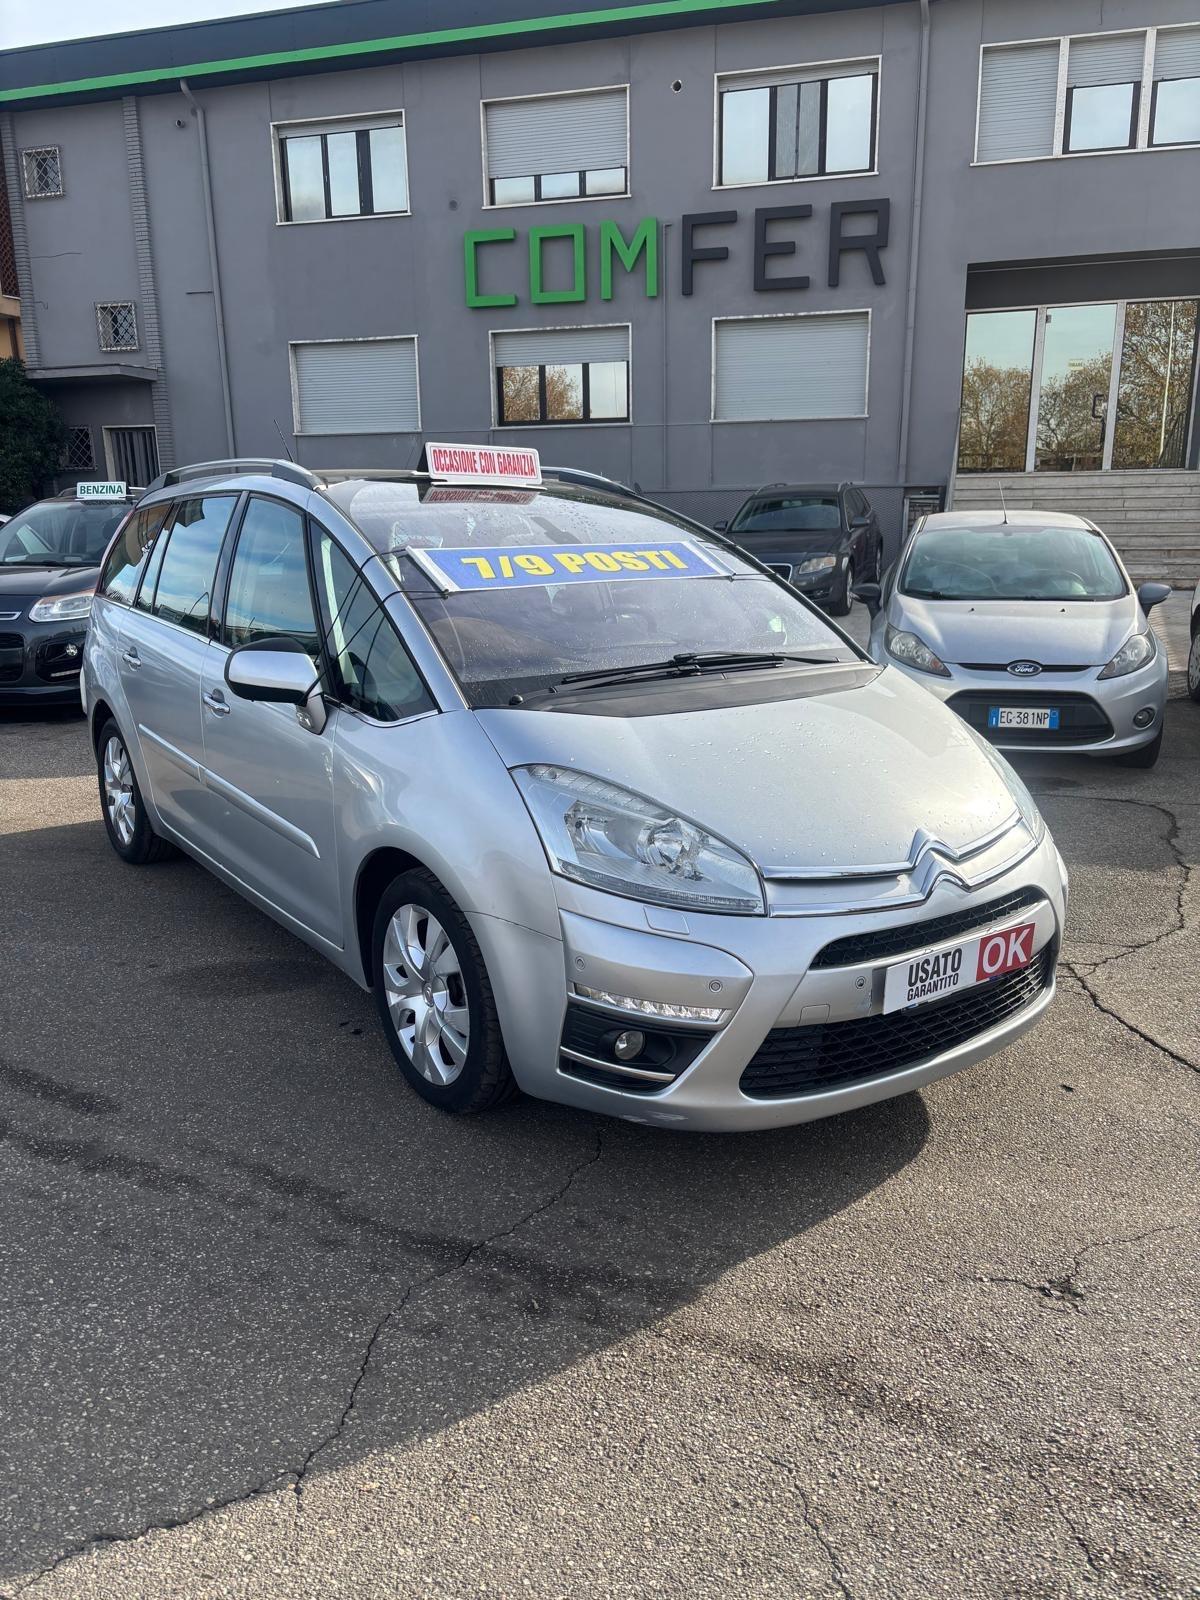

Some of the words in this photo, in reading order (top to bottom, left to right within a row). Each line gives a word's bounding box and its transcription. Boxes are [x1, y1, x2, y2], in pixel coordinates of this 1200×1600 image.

[464, 198, 890, 308] COMFER
[432, 449, 478, 473] OCCASIONE
[479, 451, 497, 474] CON
[497, 452, 536, 476] GARANZIA
[80, 485, 123, 495] BENZINA
[461, 554, 555, 579] 7/9
[552, 550, 689, 573] POSTI
[1014, 663, 1034, 673] Ford
[982, 928, 1030, 974] OK
[908, 948, 963, 987] USATO
[907, 973, 959, 1001] GARANTITO
